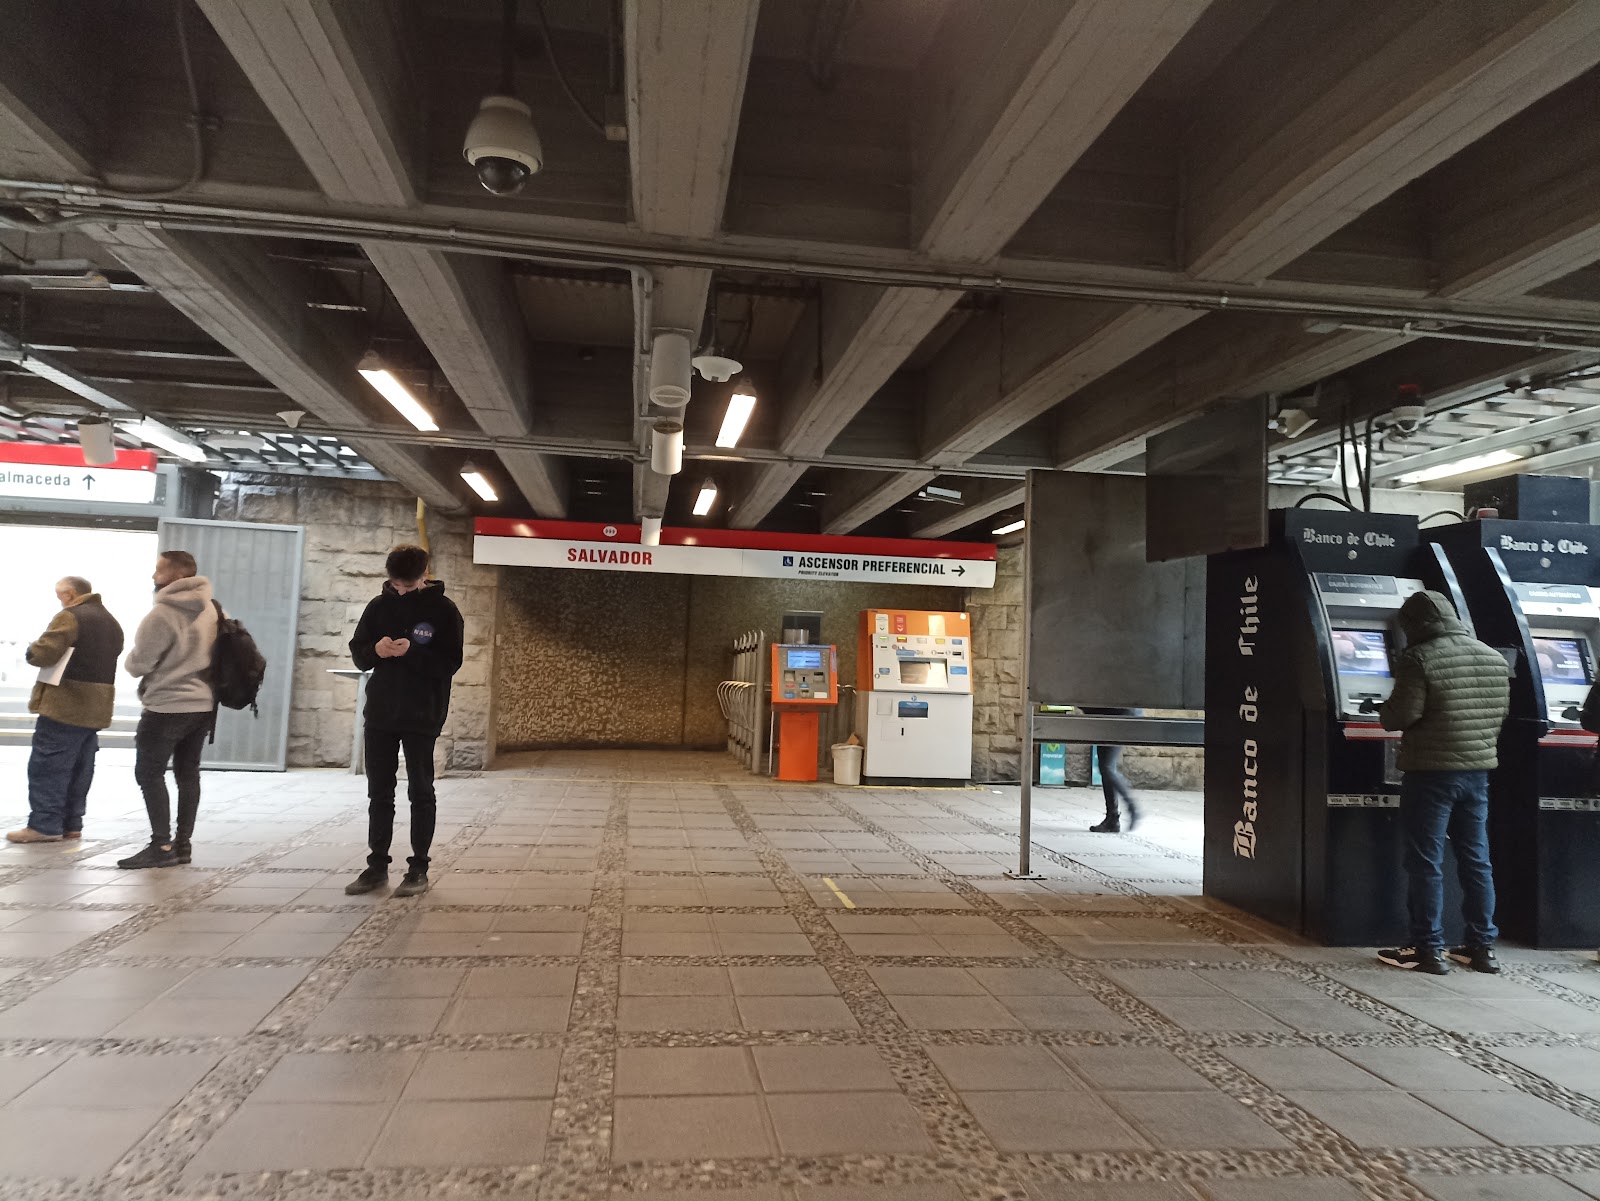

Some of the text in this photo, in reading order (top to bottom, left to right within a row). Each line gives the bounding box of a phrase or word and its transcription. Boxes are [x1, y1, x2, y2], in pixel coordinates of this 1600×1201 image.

[1303, 527, 1395, 547] Banco de Chile
[1500, 535, 1589, 554] Banco de Chile
[567, 548, 652, 565] SALVADOR
[799, 556, 946, 575] ASCENSOR PREFERENCIAL
[414, 629, 432, 637] NASA
[1239, 686, 1258, 723] de
[1233, 739, 1258, 860] Banco
